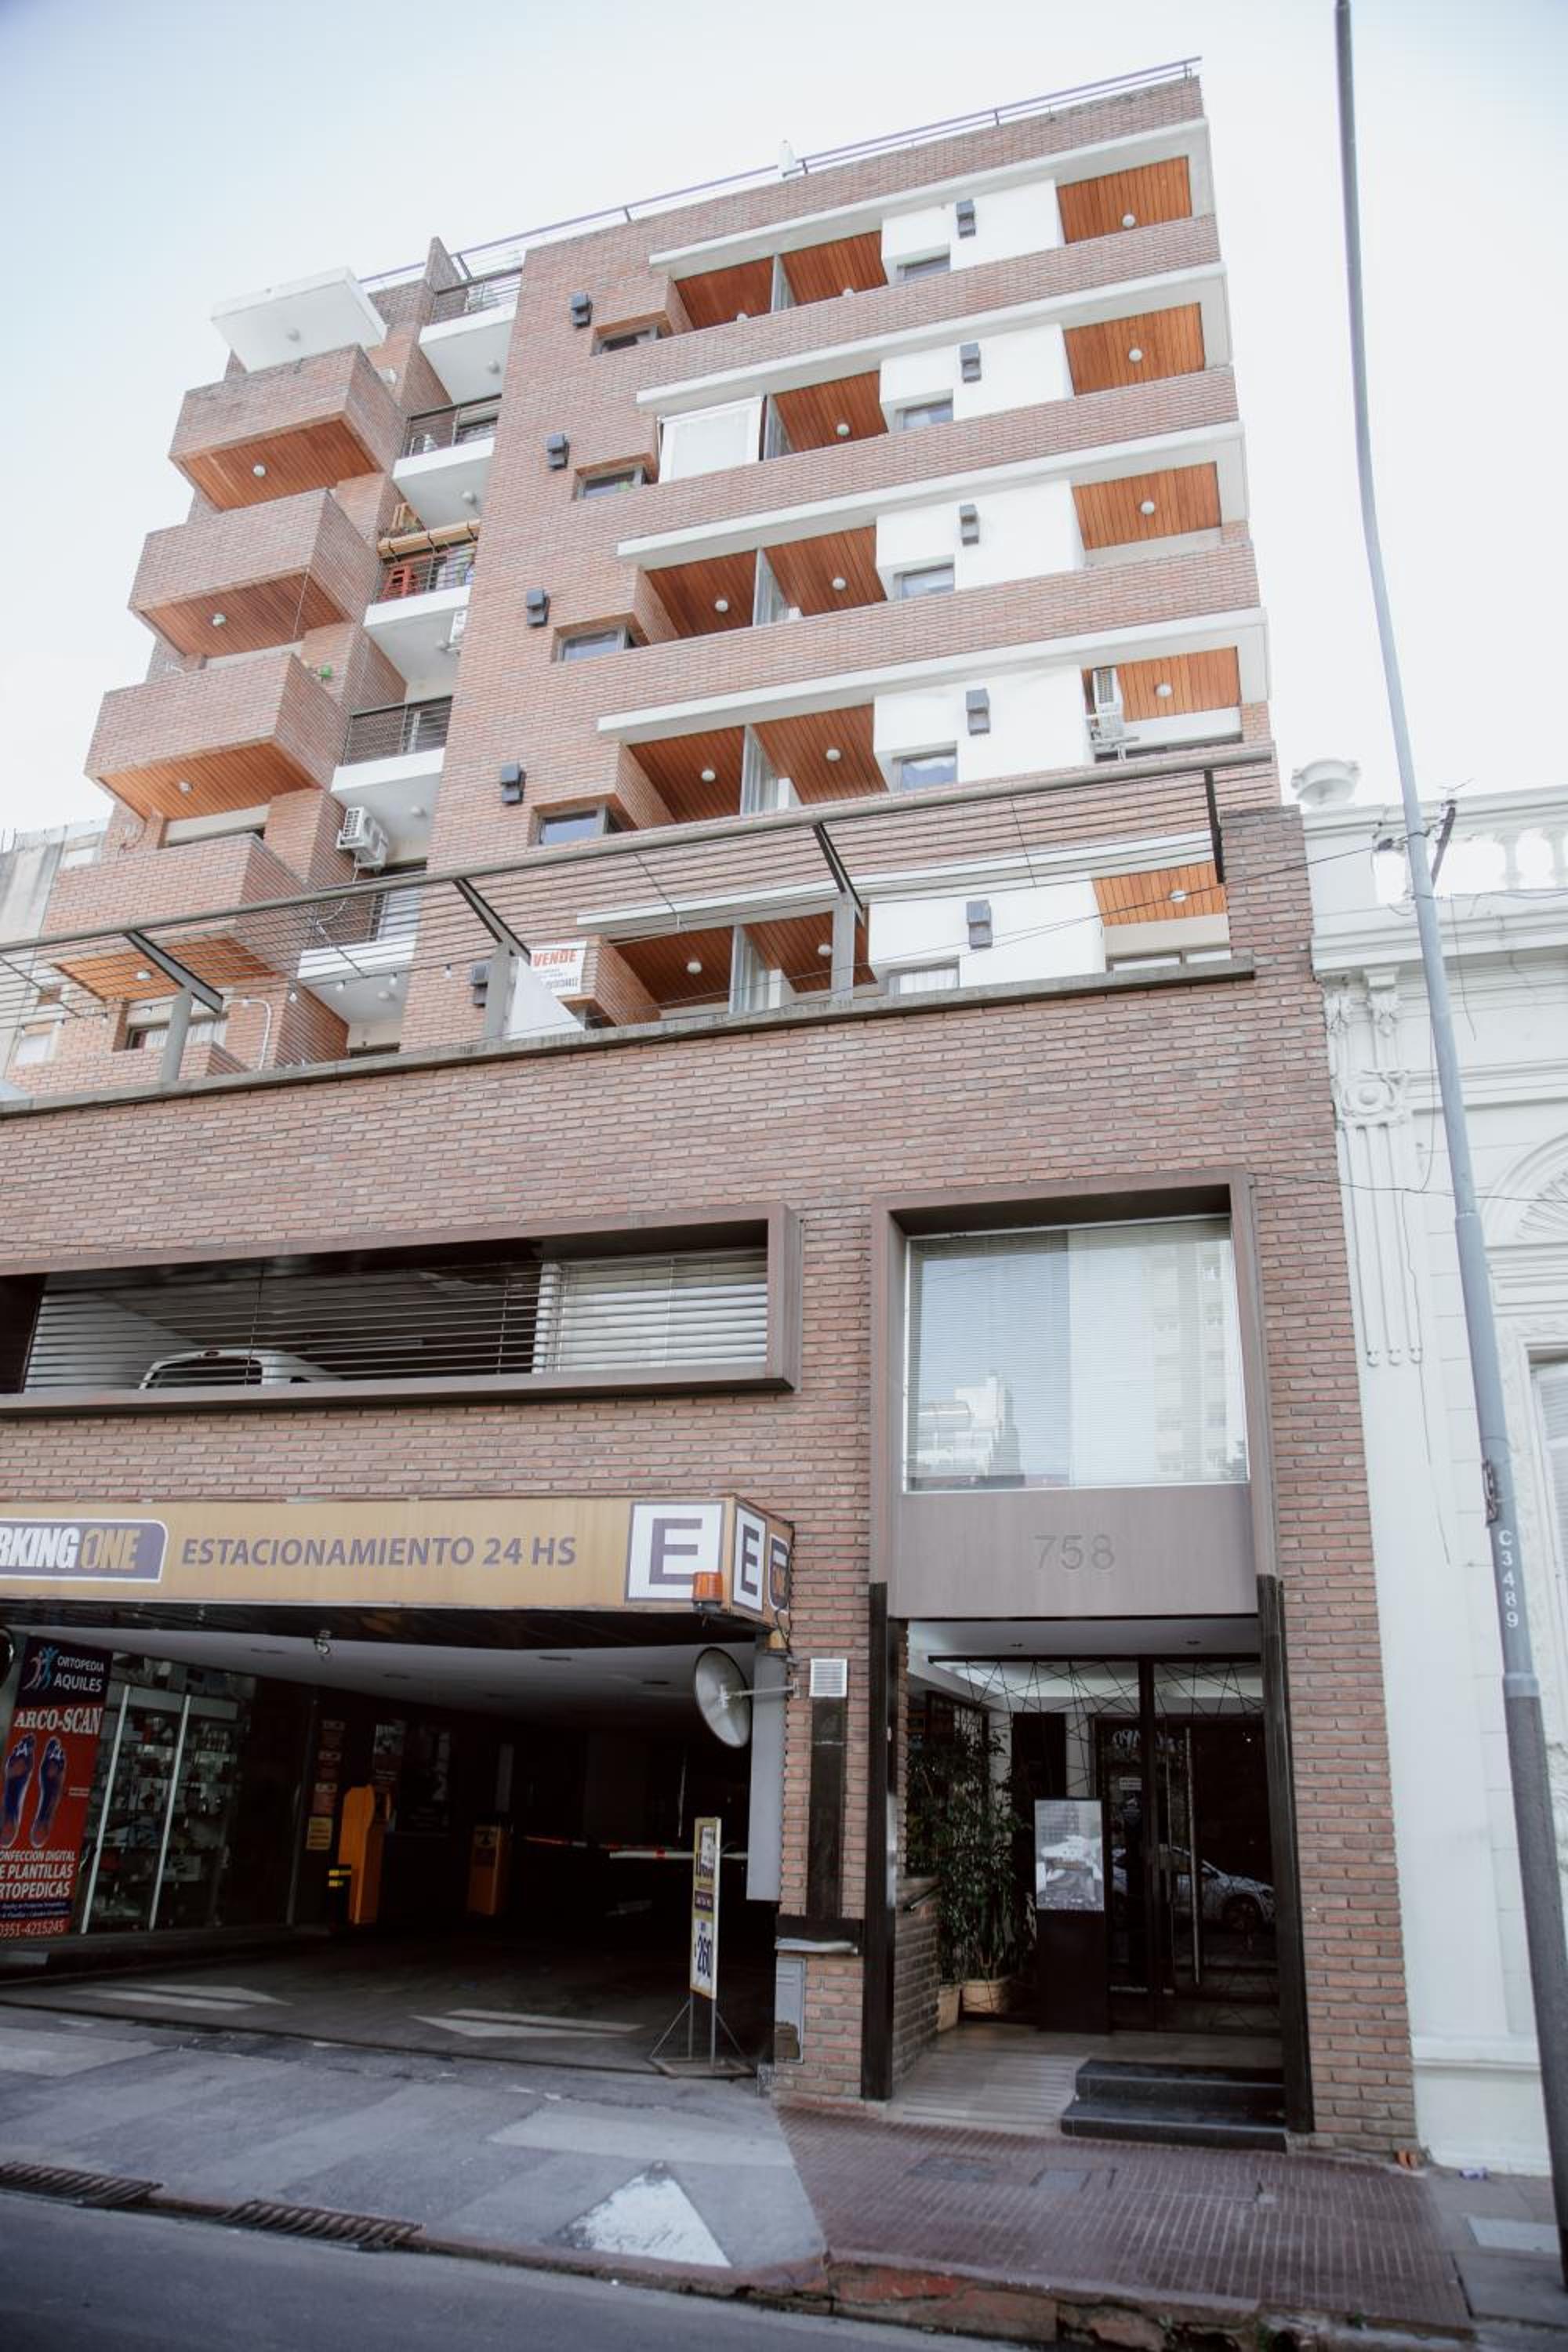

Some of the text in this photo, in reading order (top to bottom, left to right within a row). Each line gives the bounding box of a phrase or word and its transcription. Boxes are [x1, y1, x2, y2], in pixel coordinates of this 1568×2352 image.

[534, 949, 578, 967] VENDE
[181, 1536, 577, 1566] ESTACIONAMIENTO 24 HS
[649, 1517, 703, 1585] E
[740, 1523, 760, 1596] E
[1033, 1534, 1115, 1570] 758
[1498, 1530, 1519, 1628] C3489
[56, 1655, 104, 1673] ORTOPEDIA
[53, 1672, 103, 1693] AQUILES
[14, 1707, 103, 1735] ARCO-SCAN
[8, 1864, 74, 1880] PLANTILLAS
